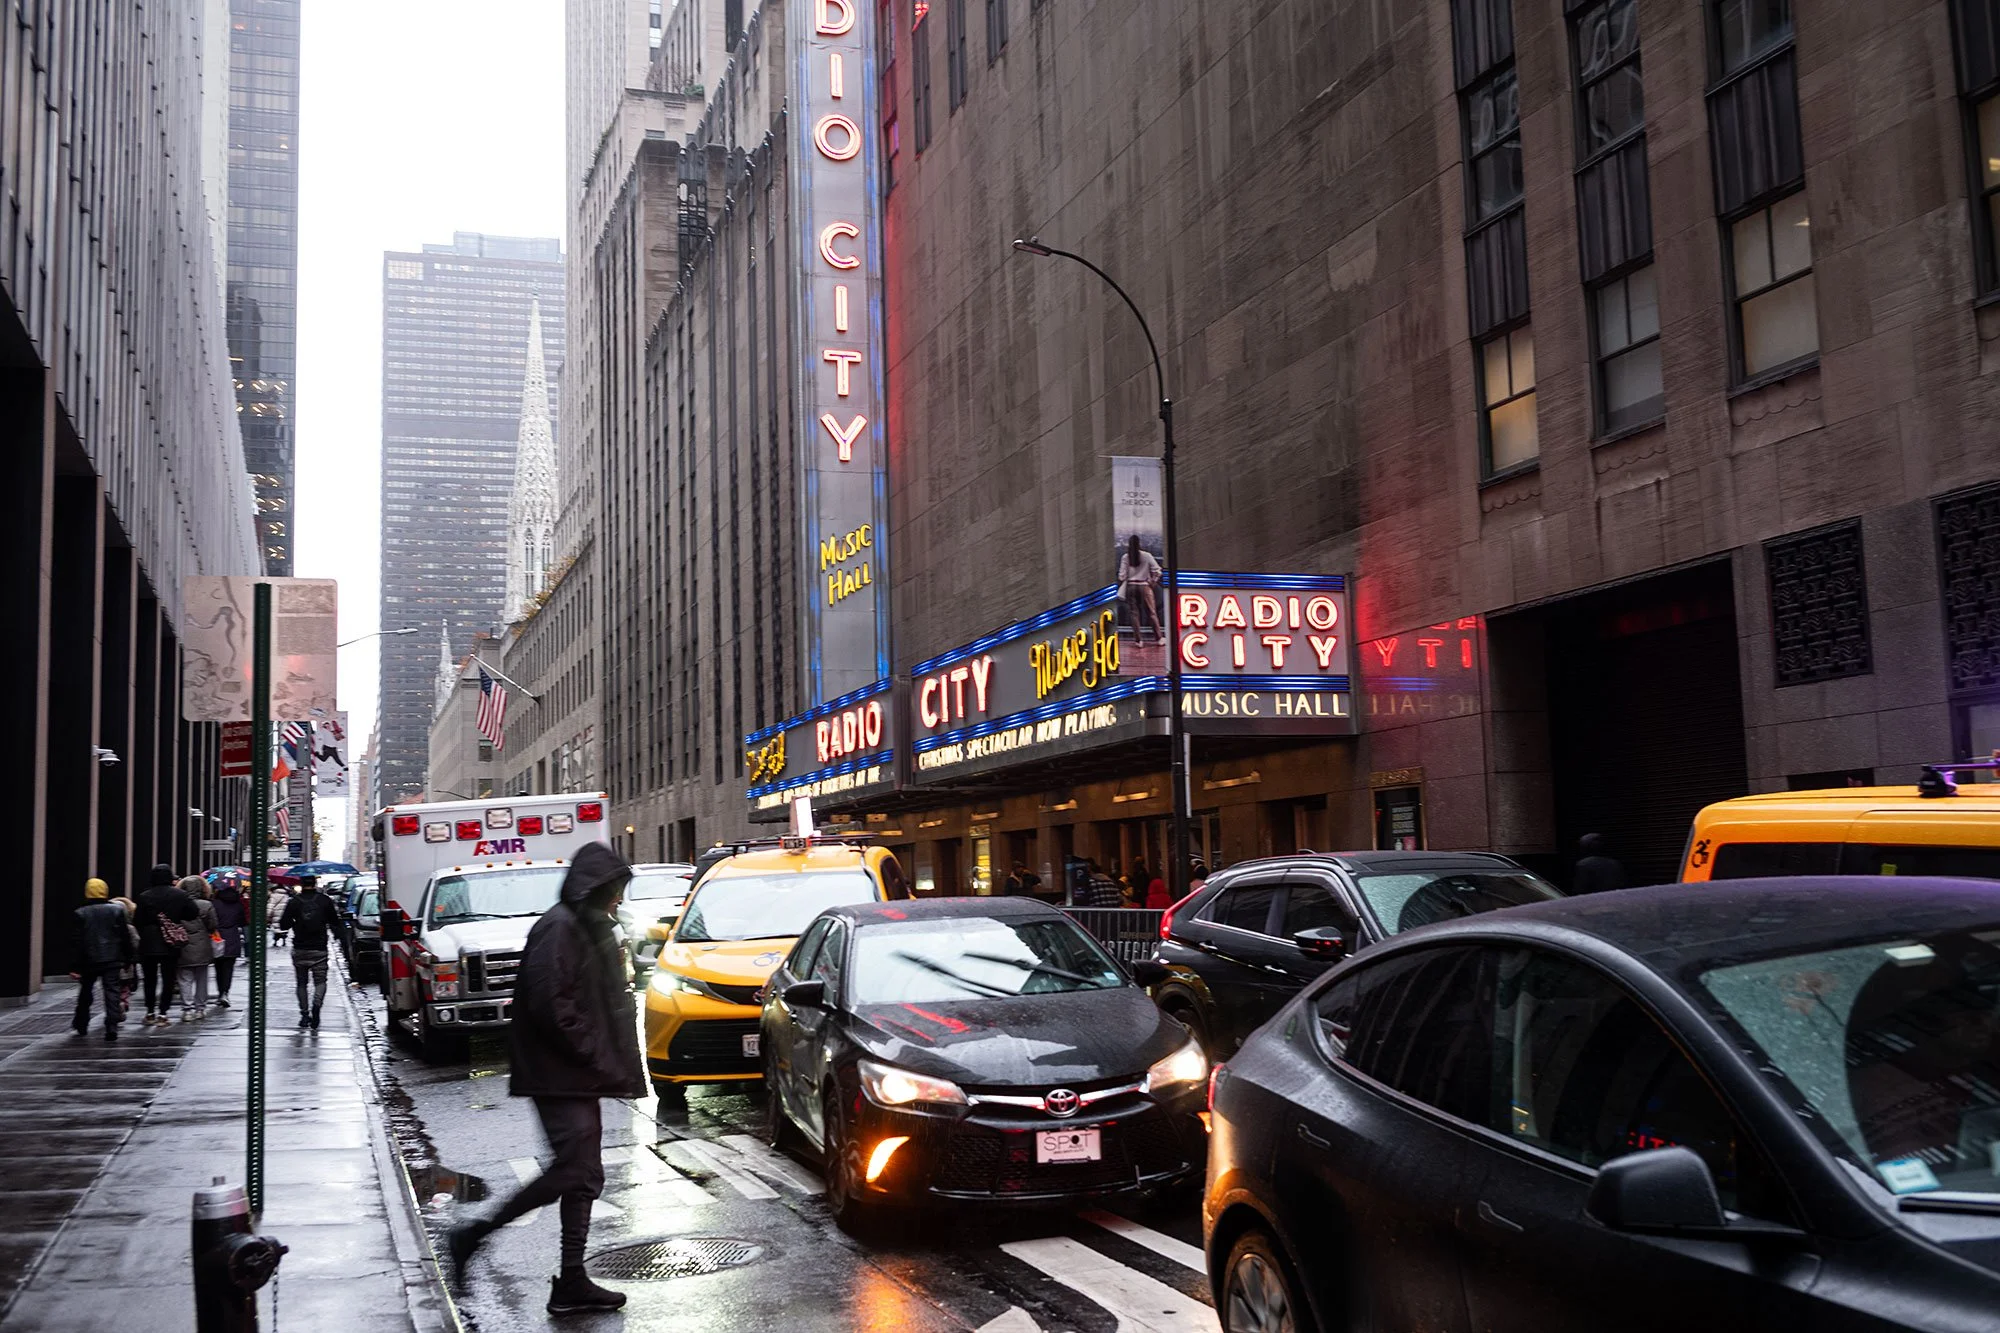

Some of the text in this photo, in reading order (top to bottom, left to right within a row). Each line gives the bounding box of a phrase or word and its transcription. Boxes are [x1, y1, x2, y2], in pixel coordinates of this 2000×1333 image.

[819, 221, 868, 462] CITY
[1178, 593, 1338, 631] RADIO
[1181, 632, 1338, 669] CITY
[920, 655, 992, 728] CITY
[1275, 692, 1347, 716] HALL
[816, 700, 883, 763] RADIO
[966, 725, 1034, 760] SPECTACULAR
[1036, 717, 1062, 743] NOW
[473, 837, 526, 857] AMR
